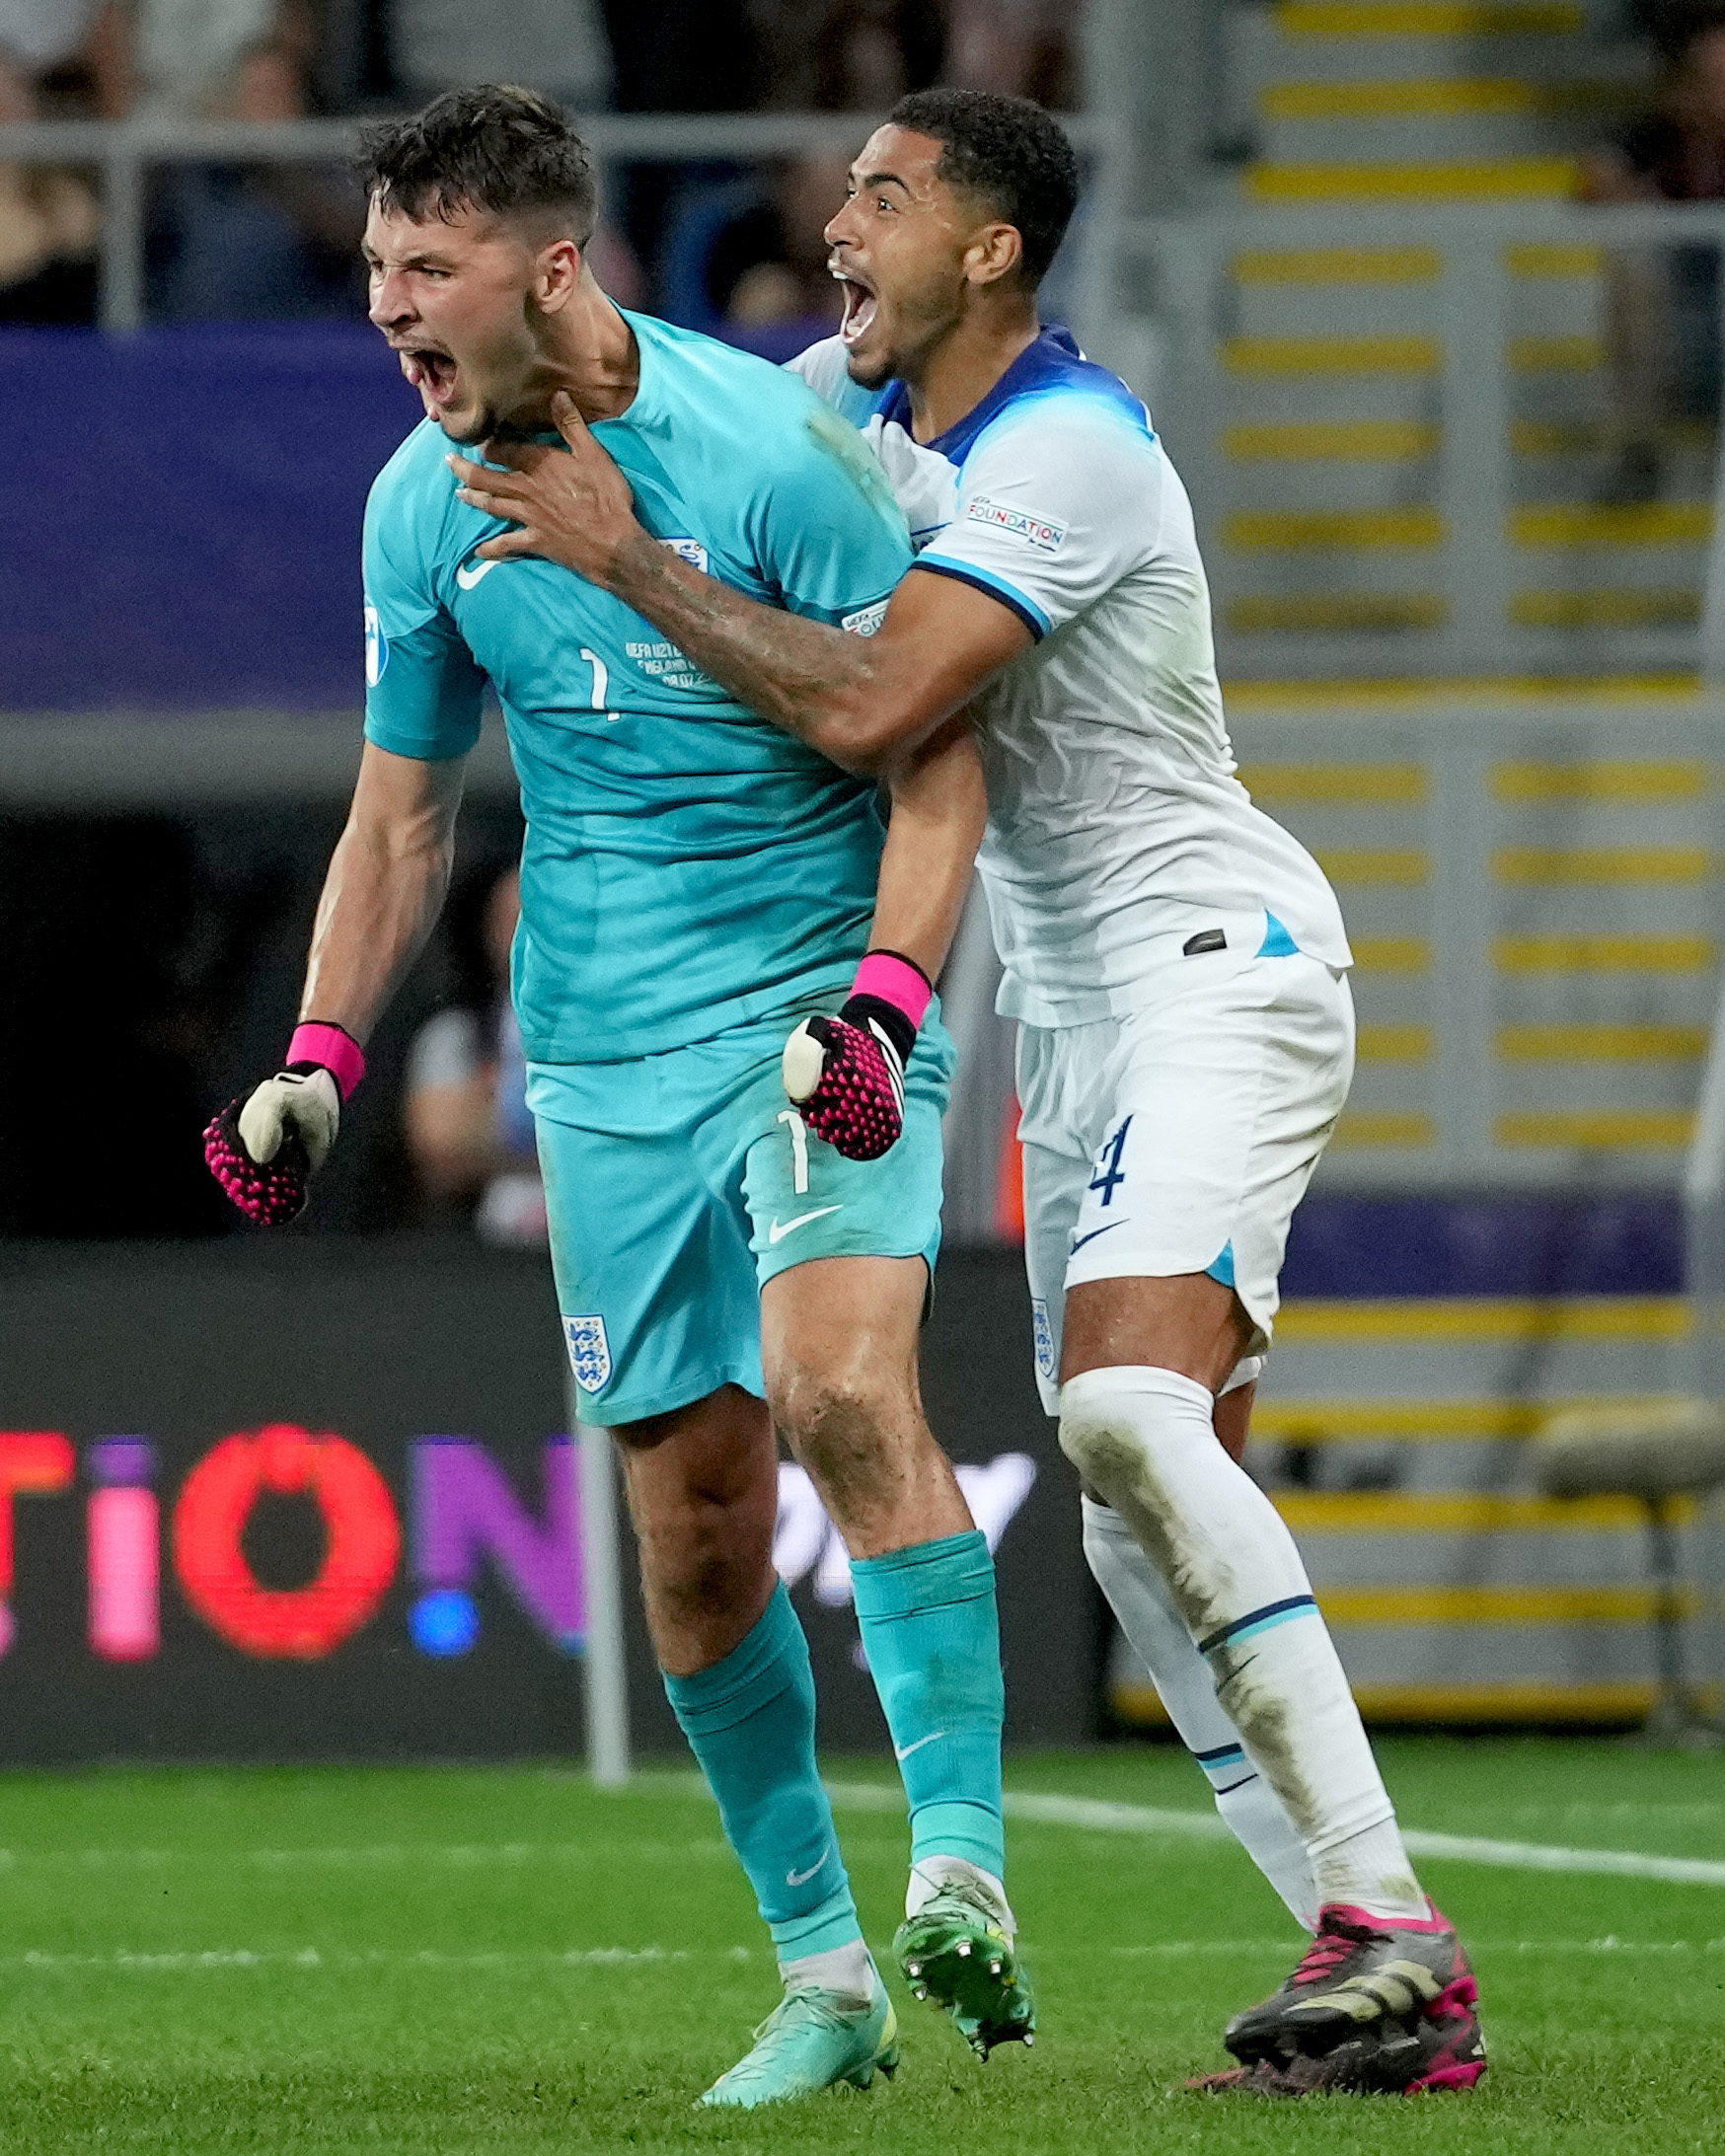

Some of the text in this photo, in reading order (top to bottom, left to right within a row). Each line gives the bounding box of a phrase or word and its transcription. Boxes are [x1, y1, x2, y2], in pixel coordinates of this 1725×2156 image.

[968, 504, 1063, 544] FOUNDATION
[580, 647, 620, 721] 1
[778, 1110, 808, 1195] 1
[1088, 1114, 1134, 1207] 4
